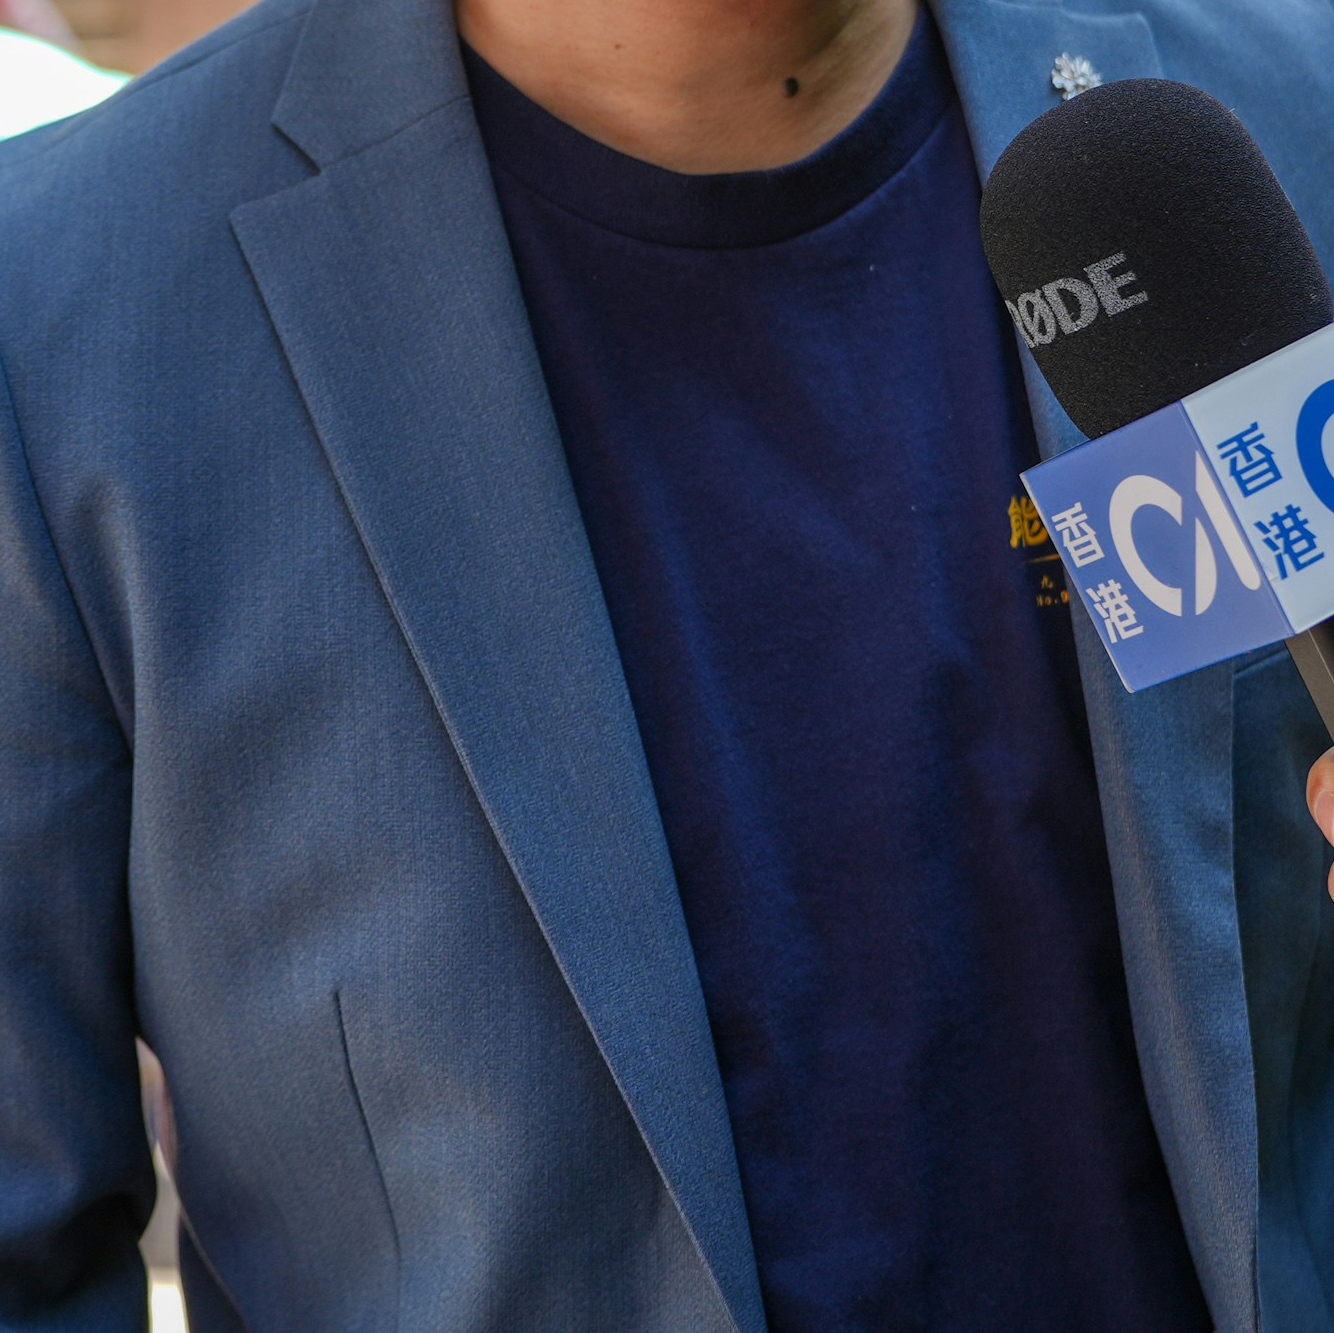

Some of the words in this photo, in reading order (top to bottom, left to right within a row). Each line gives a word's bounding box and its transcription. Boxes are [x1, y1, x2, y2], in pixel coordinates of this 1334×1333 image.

[1005, 250, 1149, 349] ØDE
[1051, 501, 1144, 644] 香港
[1108, 450, 1262, 617] 01
[1217, 422, 1325, 580] 香港
